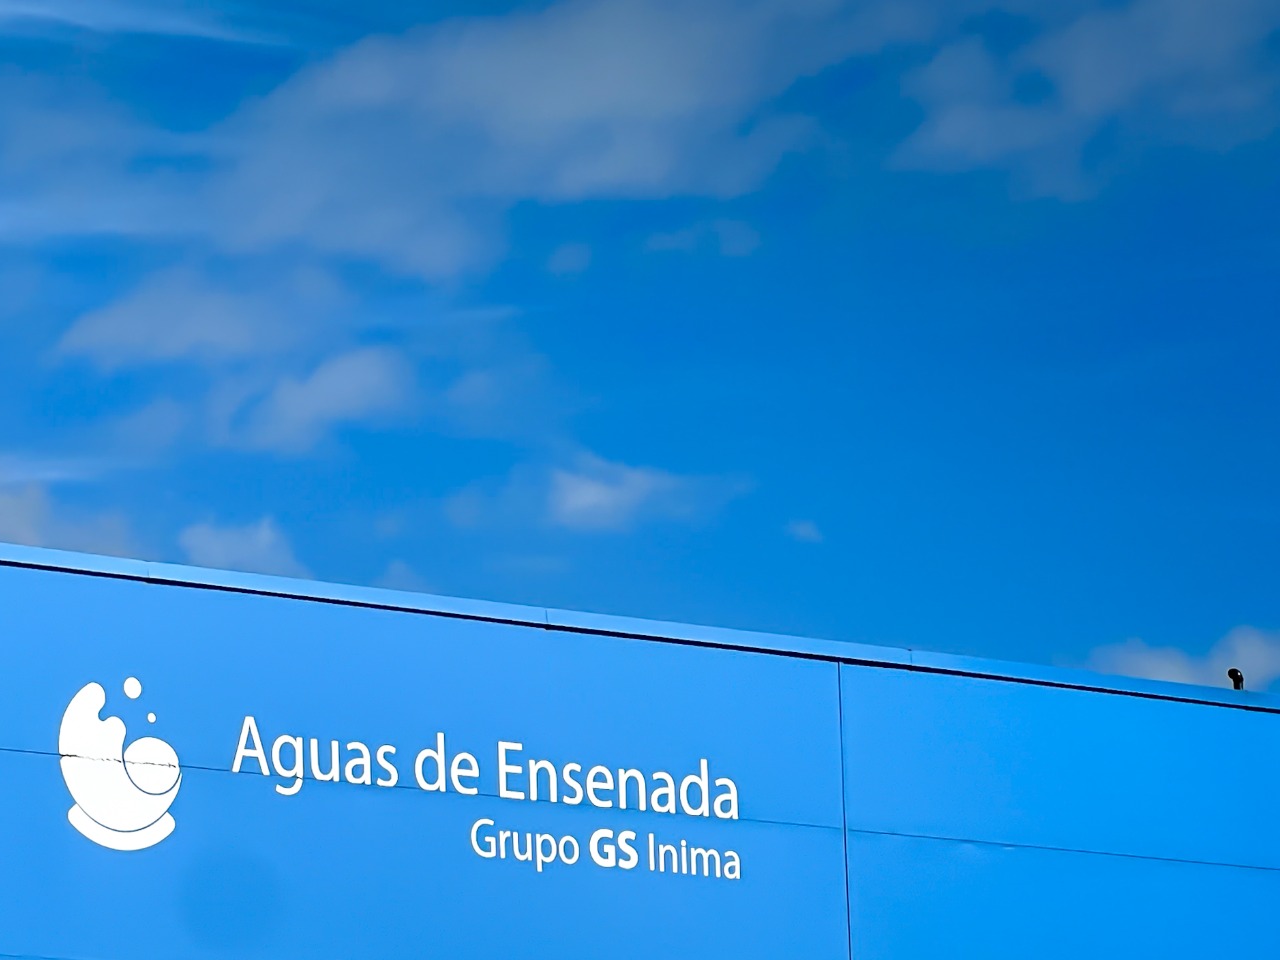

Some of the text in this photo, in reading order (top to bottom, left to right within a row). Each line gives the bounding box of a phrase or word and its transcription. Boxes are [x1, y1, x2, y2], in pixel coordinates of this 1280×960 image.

[231, 715, 739, 820] Aguas de Ensenada
[470, 818, 742, 880] Grupo GS Inima
